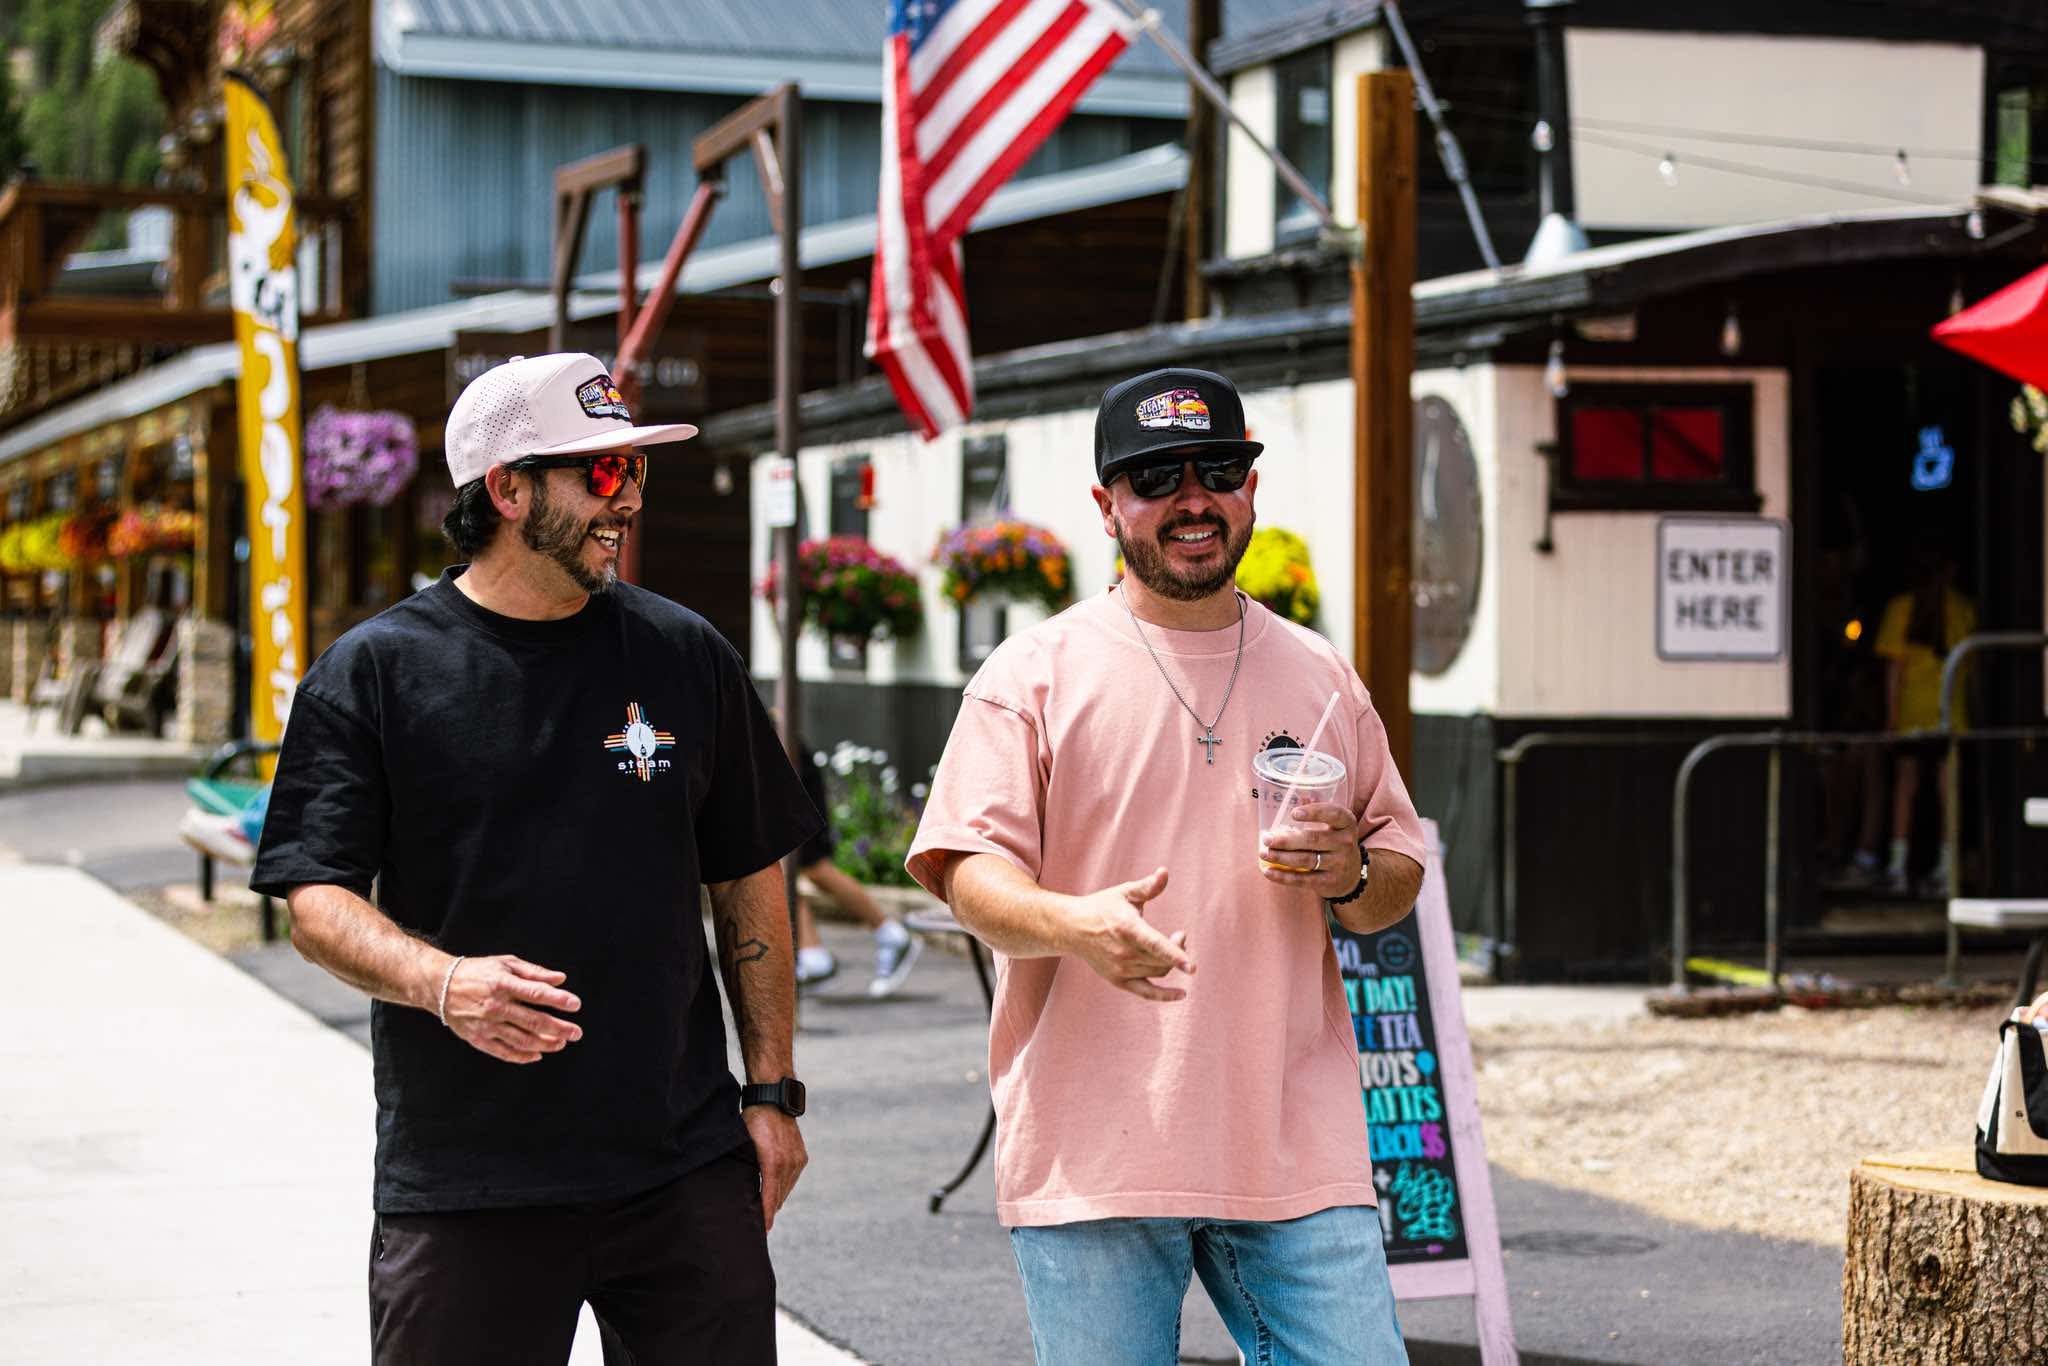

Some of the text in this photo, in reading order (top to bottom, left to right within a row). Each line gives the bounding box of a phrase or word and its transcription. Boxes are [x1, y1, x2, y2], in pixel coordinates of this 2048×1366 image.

[1139, 396, 1168, 416] STEAM
[1668, 549, 1773, 583] ENTER
[1676, 595, 1763, 630] HERE
[617, 759, 671, 770] steam
[1364, 975, 1417, 1013] DAY!
[1377, 1013, 1423, 1049] TEA
